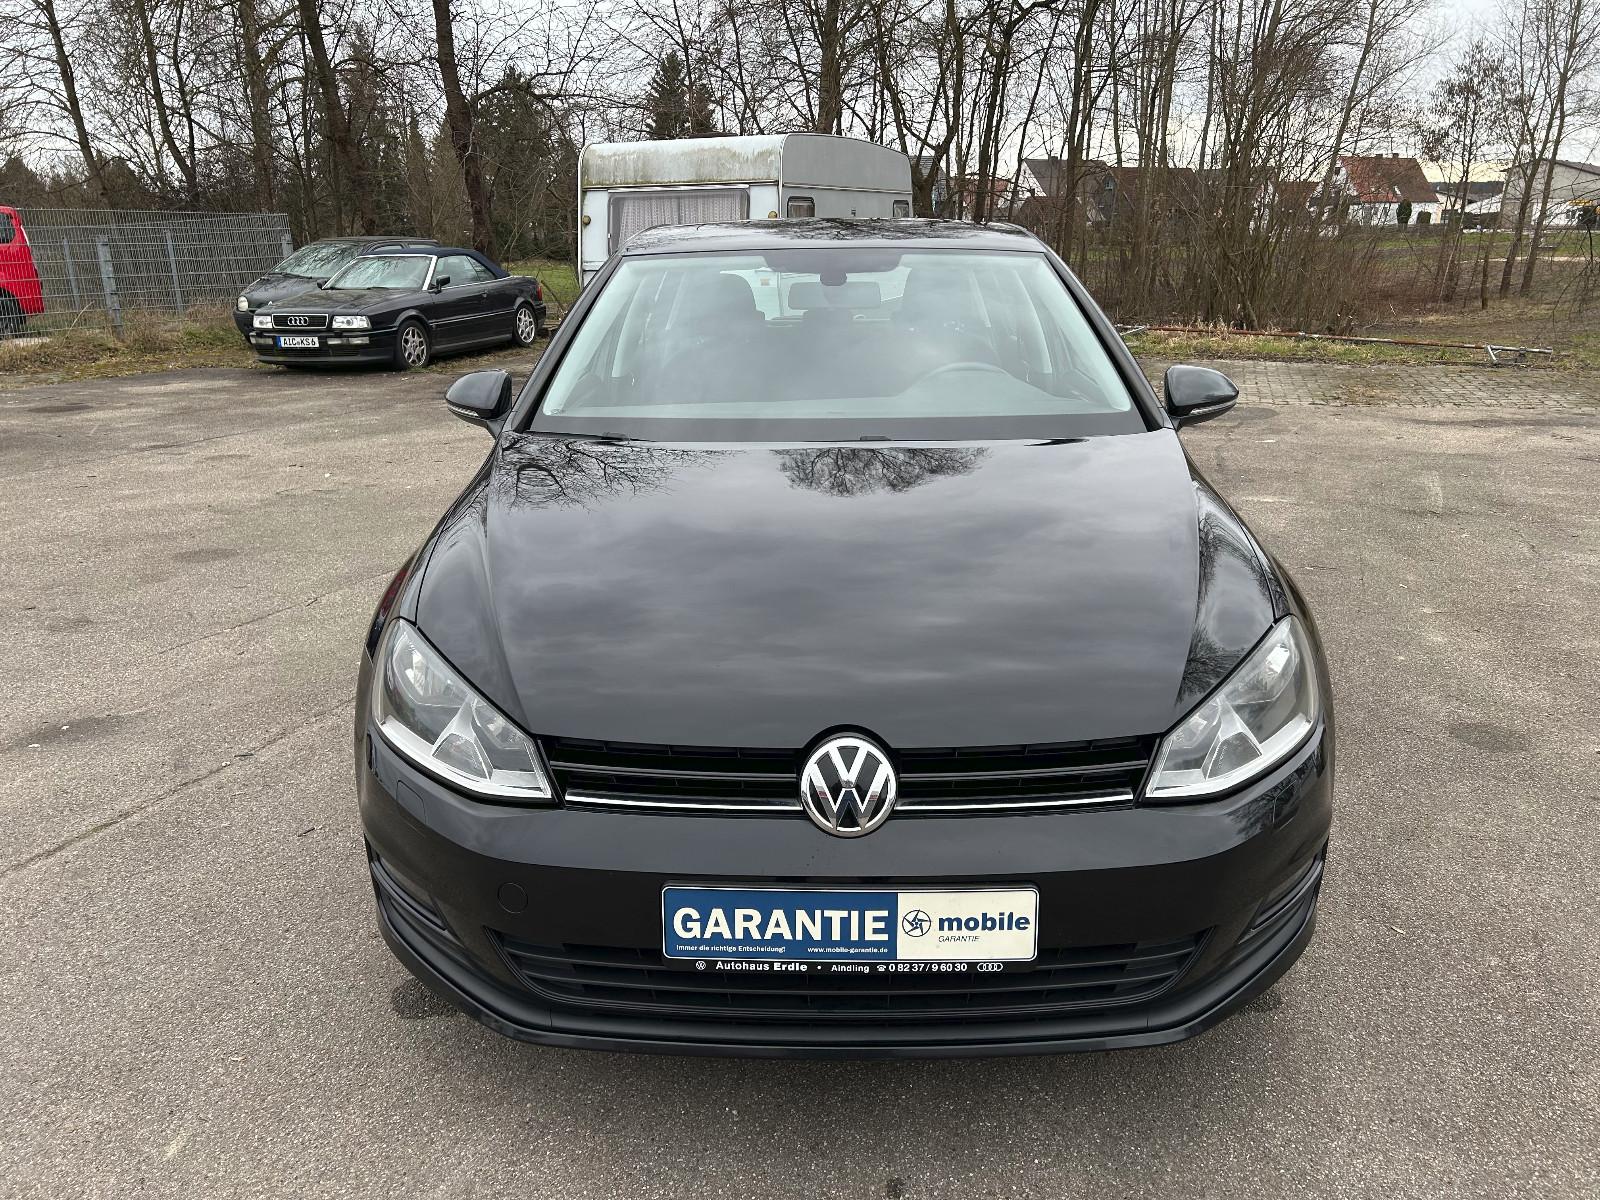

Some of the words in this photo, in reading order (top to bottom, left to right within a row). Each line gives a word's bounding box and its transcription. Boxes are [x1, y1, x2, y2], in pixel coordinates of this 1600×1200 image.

[672, 907, 889, 941] GARANTIE
[938, 912, 1031, 932] mobile
[938, 935, 981, 943] GARANTIE
[711, 945, 737, 953] richtige
[738, 945, 786, 953] Entscheidung!
[715, 961, 770, 971] Autohaus
[773, 962, 808, 972] Erdle
[831, 964, 870, 974] Aindling
